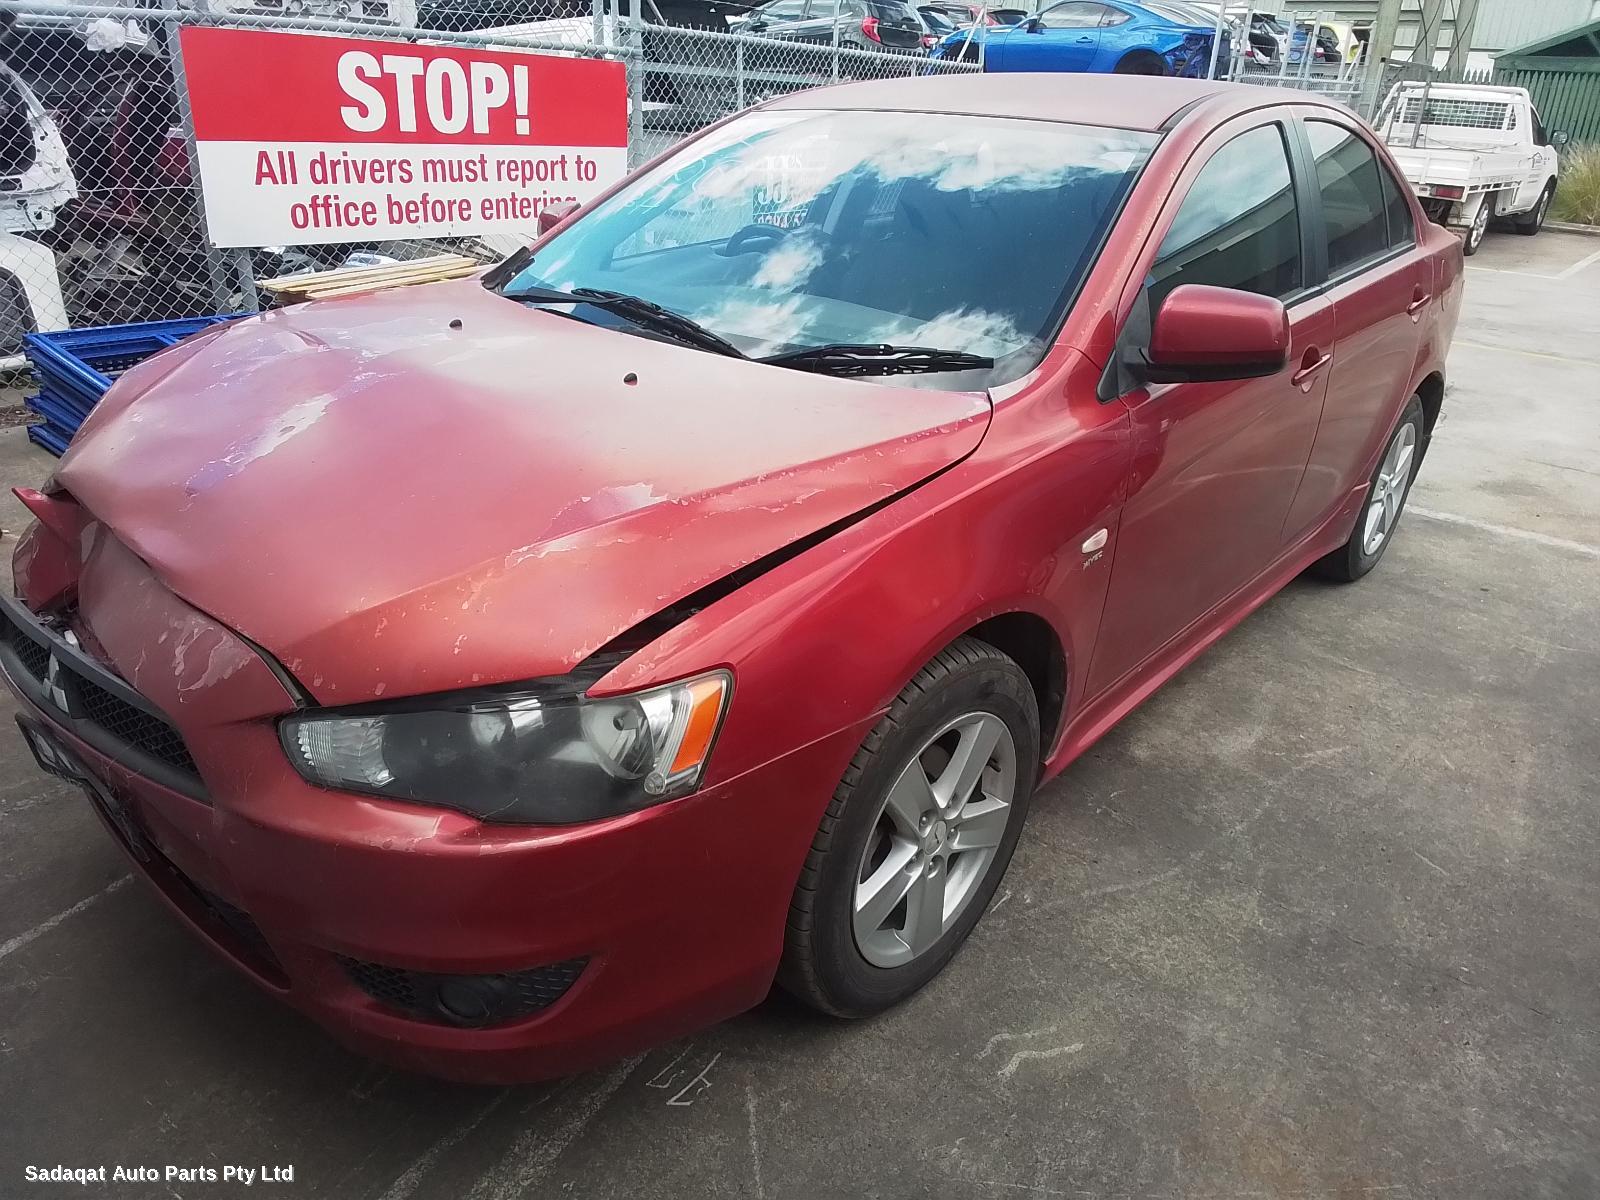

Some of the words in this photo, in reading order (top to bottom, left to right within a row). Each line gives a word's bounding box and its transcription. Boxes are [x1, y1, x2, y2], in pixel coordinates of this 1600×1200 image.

[337, 50, 531, 135] STOP!
[256, 151, 297, 185] All
[310, 152, 413, 184] drivers
[423, 154, 487, 182] must
[497, 156, 567, 186] report
[576, 158, 596, 180] to
[291, 195, 376, 228] office
[387, 193, 471, 224] before
[481, 190, 577, 219] enteri
